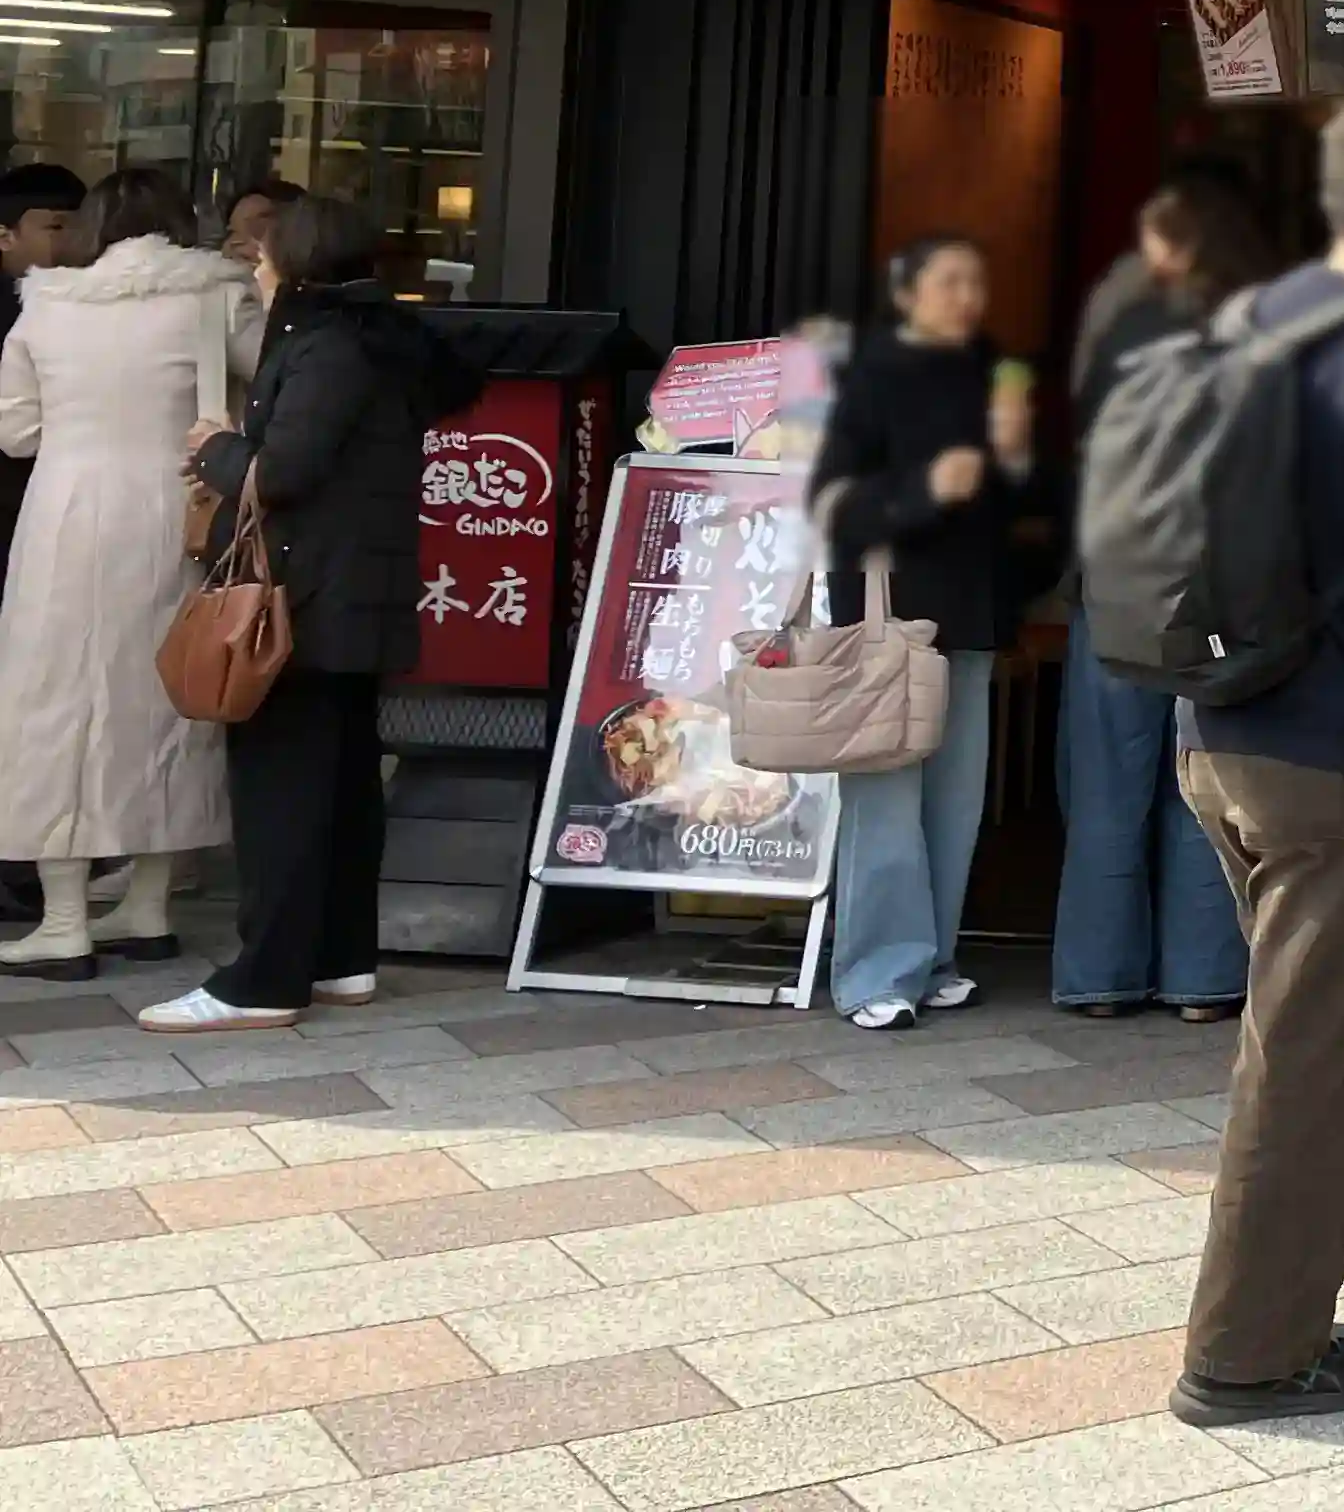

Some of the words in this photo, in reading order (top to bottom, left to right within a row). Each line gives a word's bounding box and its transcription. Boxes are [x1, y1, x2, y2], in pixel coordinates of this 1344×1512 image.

[421, 452, 528, 508] 銀だこ
[455, 513, 549, 537] GINDACO
[661, 491, 703, 575] 豚肉
[416, 563, 528, 626] 本店
